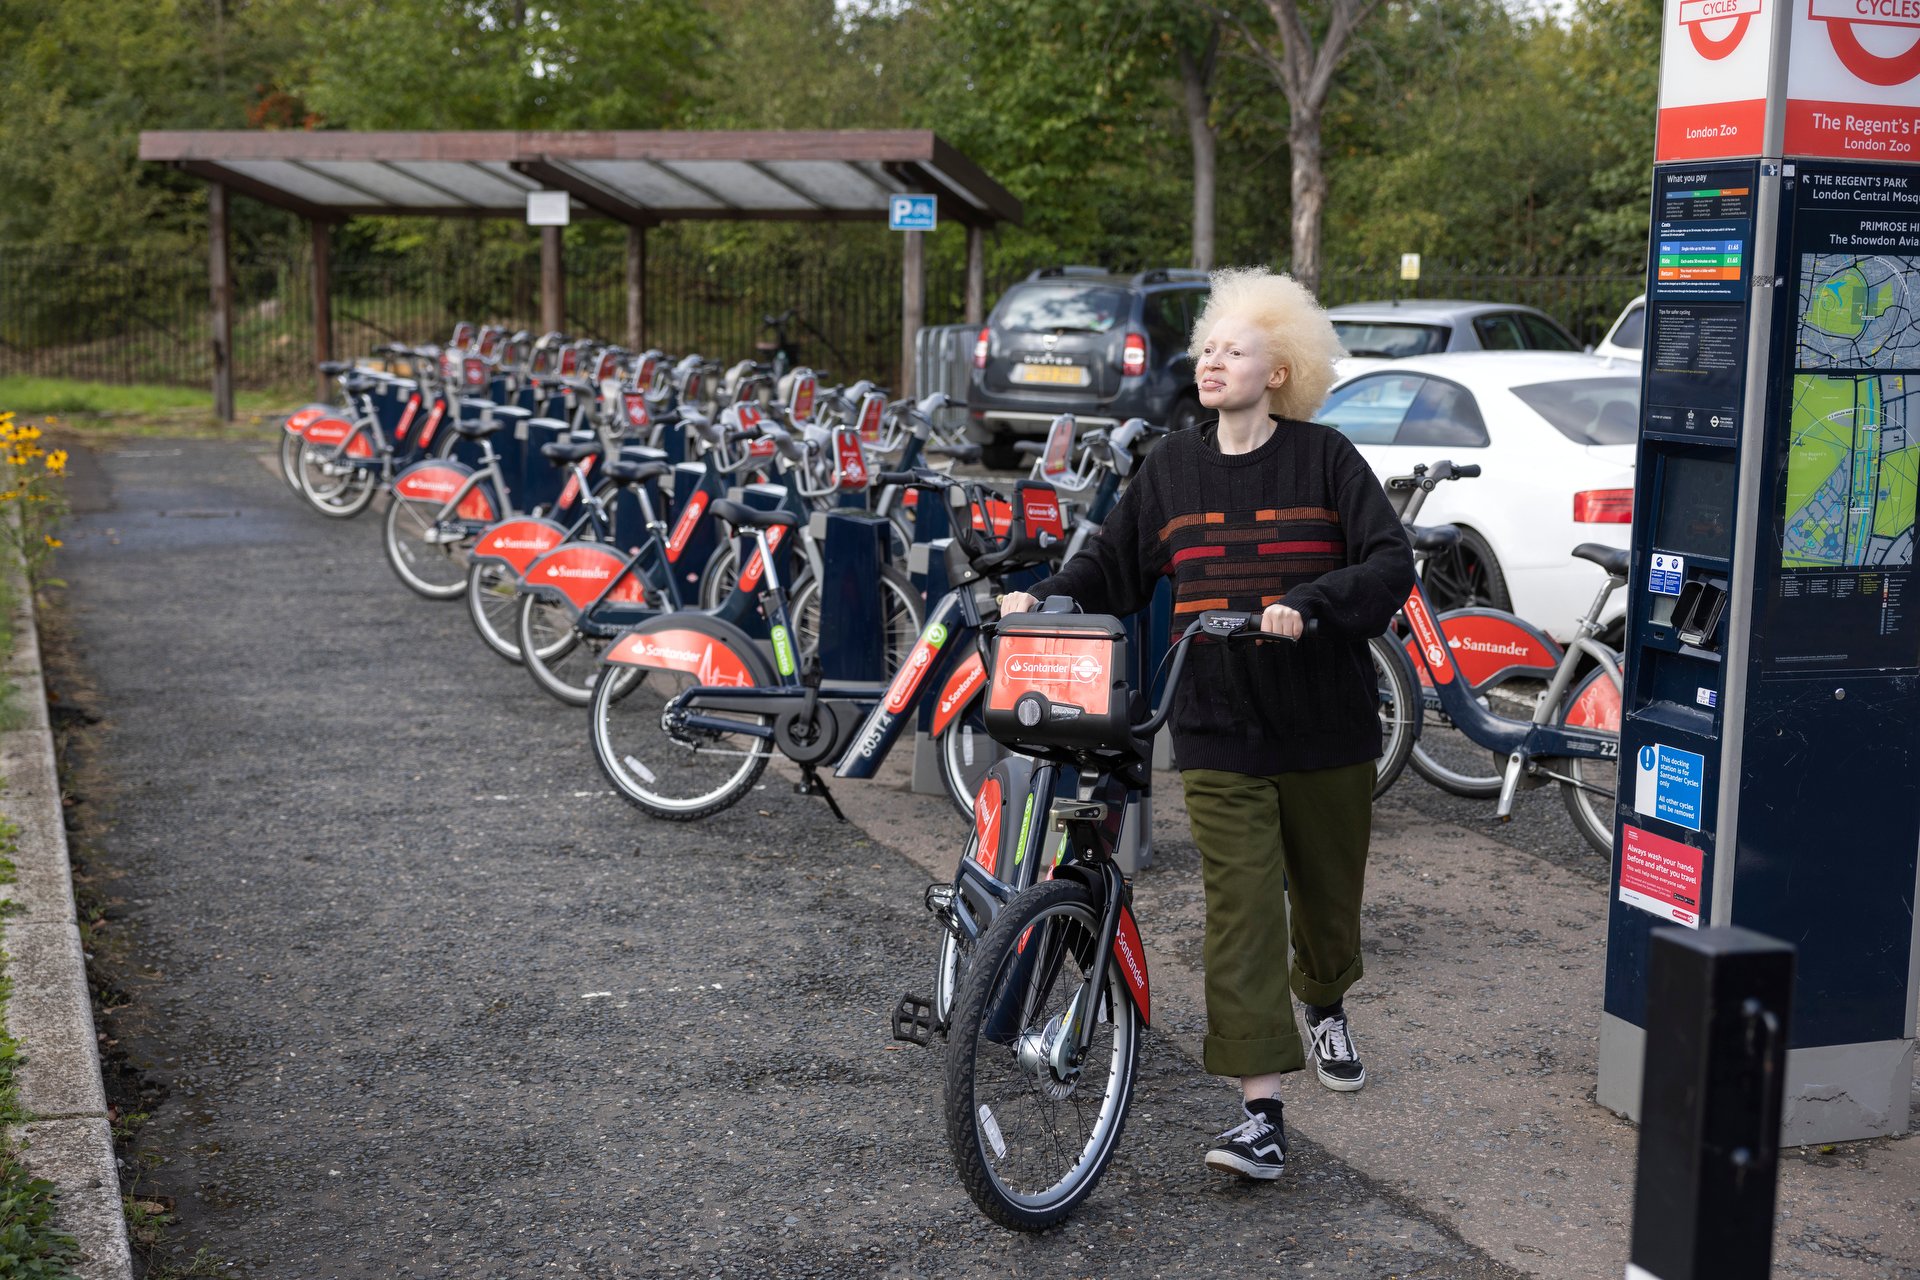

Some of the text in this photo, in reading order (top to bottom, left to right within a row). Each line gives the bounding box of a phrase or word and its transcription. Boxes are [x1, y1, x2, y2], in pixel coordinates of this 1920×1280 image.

[1703, 0, 1737, 15] CYCLES
[1686, 124, 1738, 139] London Zoo
[1813, 113, 1841, 130] The
[1845, 115, 1909, 135] Regent's
[1844, 138, 1911, 152] London Zoo
[1667, 174, 1707, 184] What you pay
[1814, 175, 1907, 188] THE REGENT'S PARK
[1813, 189, 1850, 200] London
[1853, 190, 1890, 202] Central
[895, 199, 912, 224] P
[1860, 221, 1907, 232] PRIMROSE
[1830, 234, 1848, 245] The
[1851, 235, 1896, 246] Snowdon
[558, 565, 610, 579] Santander
[1414, 607, 1432, 643] Santander
[646, 644, 702, 663] Santander
[1462, 637, 1529, 657] Santander
[779, 641, 790, 672] Electric
[1023, 662, 1068, 673] Santander
[948, 665, 982, 704] Santander
[860, 714, 892, 758] 60514
[1660, 764, 1677, 772] station
[1671, 758, 1689, 769] docking
[1659, 780, 1669, 788] only
[1660, 771, 1699, 788] Santander Cycles
[1666, 797, 1679, 806] other
[1679, 802, 1694, 811] cycles
[1674, 808, 1695, 819] removed
[1627, 844, 1694, 873] Always wash your hands
[1627, 854, 1696, 884] before and after you travel
[1641, 869, 1650, 878] help
[1660, 877, 1676, 887] everyone
[1119, 932, 1144, 989] Santander
